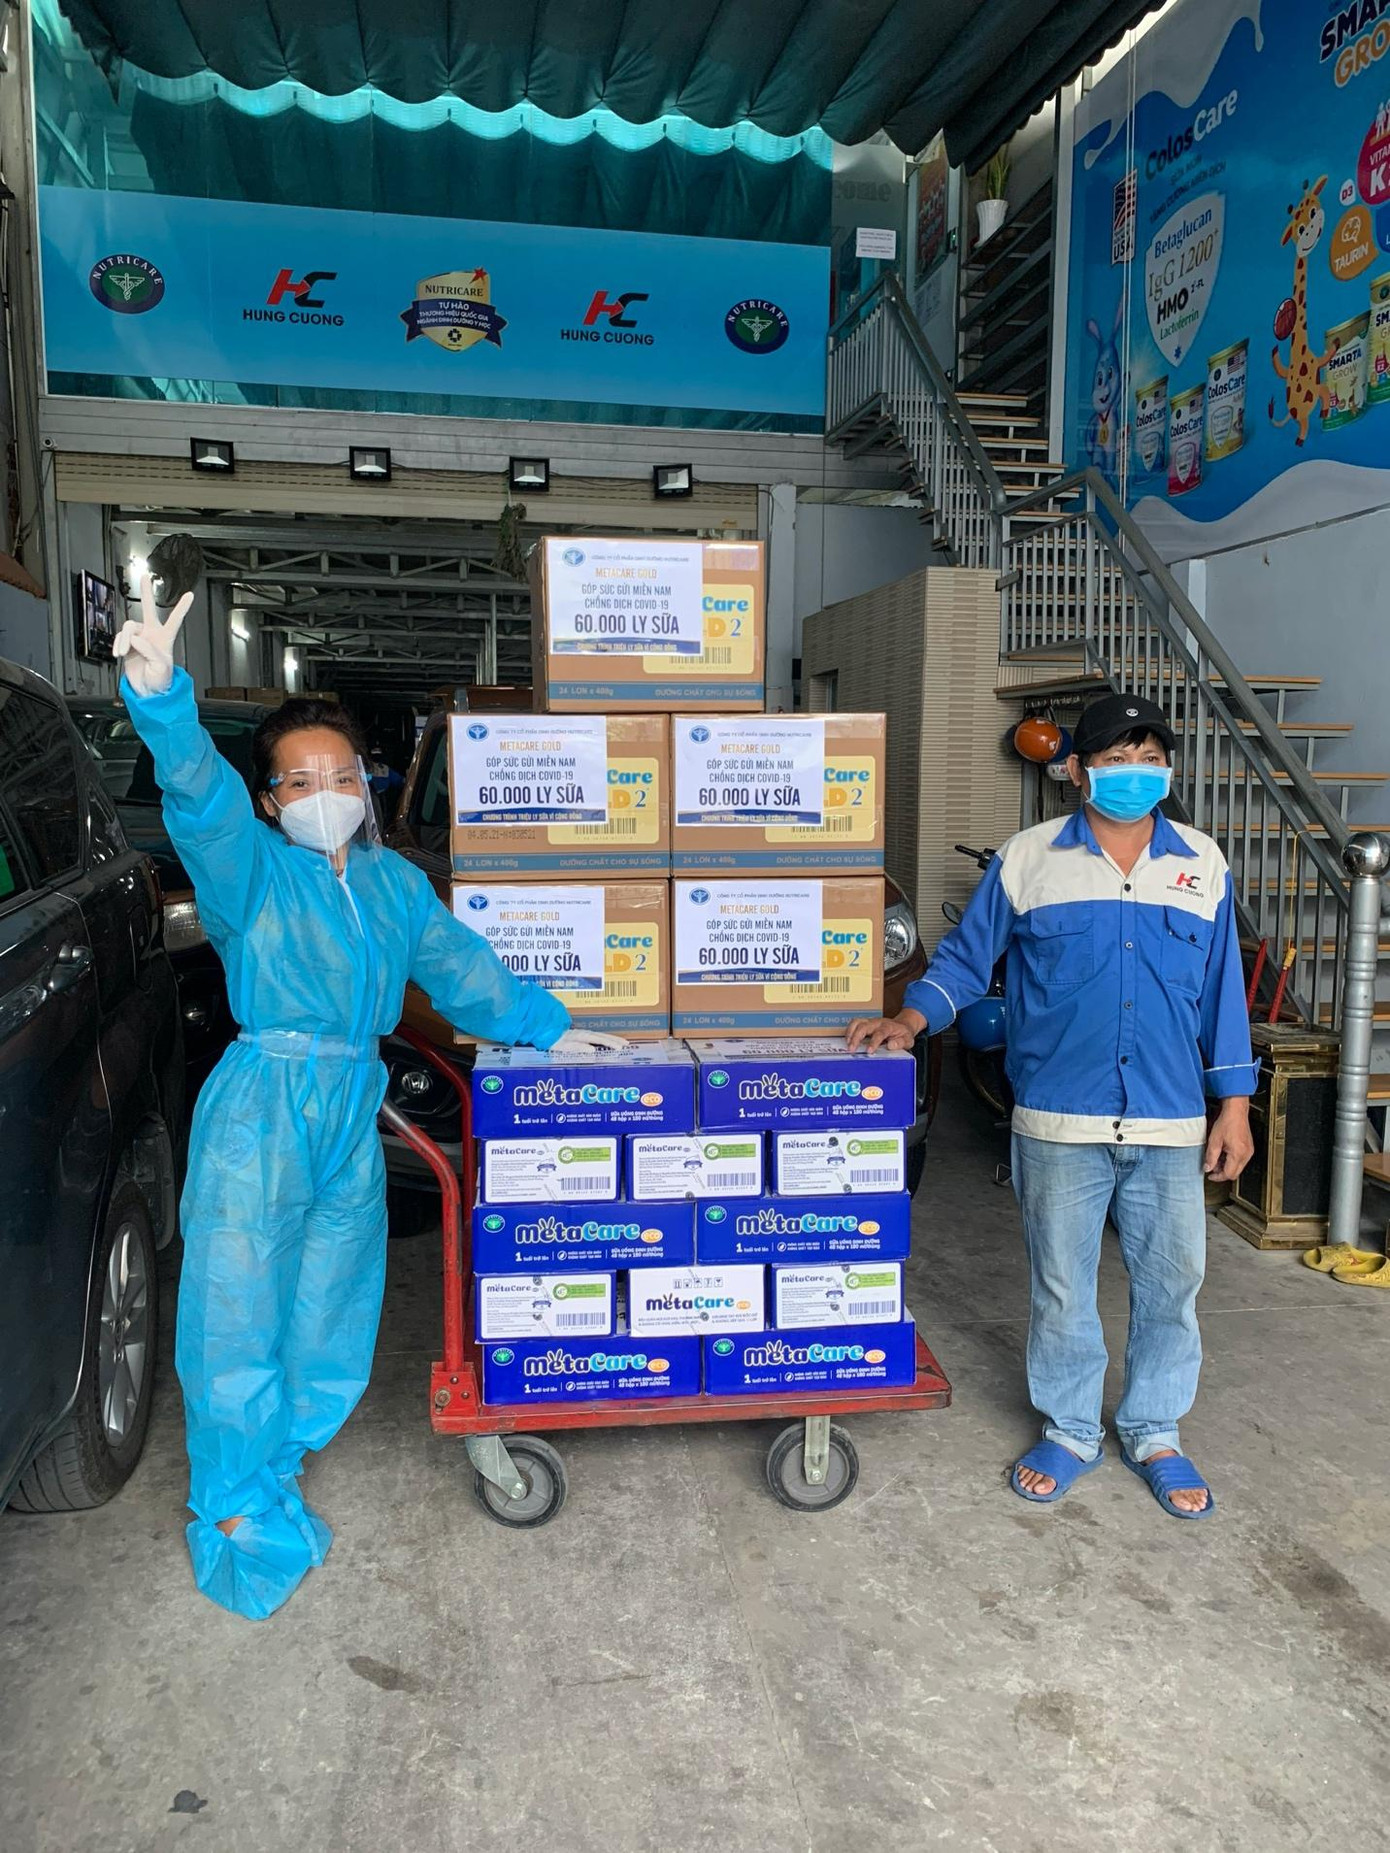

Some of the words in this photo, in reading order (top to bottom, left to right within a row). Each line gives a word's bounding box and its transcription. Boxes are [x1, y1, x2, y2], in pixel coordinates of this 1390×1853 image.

[1320, 0, 1390, 62] SMA
[1146, 89, 1238, 181] ColosCare
[1342, 185, 1353, 201] D3
[1154, 209, 1212, 259] Betaglucan
[1334, 242, 1369, 273] TAURIN
[92, 255, 163, 286] NUTRICARE
[1149, 259, 1175, 302] IgG
[425, 285, 484, 297] NUTRICARE
[728, 299, 788, 328] NUTRICARE
[1157, 288, 1188, 324] HMO
[243, 309, 286, 324] HUNG
[290, 311, 345, 327] CUONG
[1160, 308, 1199, 340] Lactoferrin
[561, 329, 600, 343] HUNG
[604, 330, 654, 345] CUONG
[1328, 347, 1362, 370] SMARTA
[1333, 363, 1358, 381] GROW
[1208, 373, 1246, 400] ColosCare
[1136, 405, 1166, 429] ColosCare
[1170, 415, 1203, 438] ColosCare
[595, 567, 635, 579] METACARE
[637, 568, 657, 579] GOLD
[581, 583, 597, 595] GÓP
[599, 583, 615, 595] SỨC
[617, 583, 631, 595] GỬI
[632, 584, 652, 596] MIỀN
[654, 586, 672, 596] NAM
[584, 595, 612, 610] CHỐNG
[614, 599, 632, 611] DỊCH
[634, 599, 669, 610] COVID-19
[574, 614, 627, 634] 60.000
[632, 616, 648, 634] LY
[651, 612, 680, 634] SỮA
[730, 618, 741, 637] 2
[500, 741, 539, 751] METACARE
[541, 741, 561, 751] GOLD
[721, 744, 759, 754] METACARE
[761, 744, 781, 754] GOLD
[486, 757, 501, 768] GÓP
[503, 757, 519, 768] SỨC
[521, 757, 535, 768] GỬI
[536, 757, 557, 767] MIỀN
[559, 758, 576, 767] NAM
[706, 759, 722, 769] GÓP
[723, 759, 739, 769] SỨC
[740, 759, 754, 769] GỬI
[755, 759, 775, 769] MIỀN
[777, 760, 794, 769] NAM
[489, 768, 516, 781] CHỐNG
[518, 771, 536, 783] DỊCH
[538, 771, 574, 780] COVID-19
[709, 770, 735, 783] CHỐNG
[737, 773, 756, 784] DỊCH
[757, 773, 791, 783] COVID-19
[479, 786, 531, 805] 60.000
[536, 786, 552, 804] LY
[556, 783, 585, 804] SỮA
[635, 789, 646, 808] 2
[699, 788, 750, 806] 60.000
[755, 788, 770, 806] LY
[773, 785, 801, 806] SỮA
[851, 788, 863, 806] 2
[532, 813, 537, 821] LY
[475, 859, 493, 867] LON
[825, 856, 842, 864] CHO
[1166, 885, 1183, 893] HUNG
[1184, 888, 1204, 898] CUONG
[500, 911, 538, 921] METACARE
[540, 911, 560, 921] GOLD
[720, 905, 759, 915] METACARE
[760, 905, 779, 914] GOLD
[485, 926, 501, 937] GÓP
[503, 926, 518, 937] SỨC
[520, 926, 533, 937] GỬI
[535, 926, 554, 937] MIỀN
[556, 927, 574, 937] NAM
[706, 920, 722, 930] GÓP
[723, 920, 738, 930] SỨC
[739, 919, 752, 930] GỬI
[755, 919, 774, 929] MIỀN
[776, 920, 792, 929] NAM
[517, 940, 535, 951] DỊCH
[536, 939, 571, 950] COVID-19
[605, 933, 653, 949] Care
[709, 930, 735, 943] CHỐNG
[736, 933, 754, 944] DỊCH
[756, 932, 790, 942] COVID-19
[501, 955, 529, 972] 000
[534, 955, 549, 972] LY
[554, 952, 581, 972] SỮA
[635, 953, 647, 971] 2
[699, 947, 749, 965] 60.000
[753, 948, 768, 965] LY
[772, 945, 799, 965] SỮA
[848, 949, 860, 967] 2
[513, 1078, 641, 1107] metaCare
[738, 1072, 861, 1101] metaCare
[643, 1095, 660, 1104] eco
[514, 1114, 521, 1124] 1
[515, 1216, 641, 1245] metaCare
[736, 1208, 858, 1236] metaCare
[646, 1293, 735, 1311] metaCare
[744, 1340, 865, 1367] metaCare
[524, 1349, 648, 1377] metaCare
